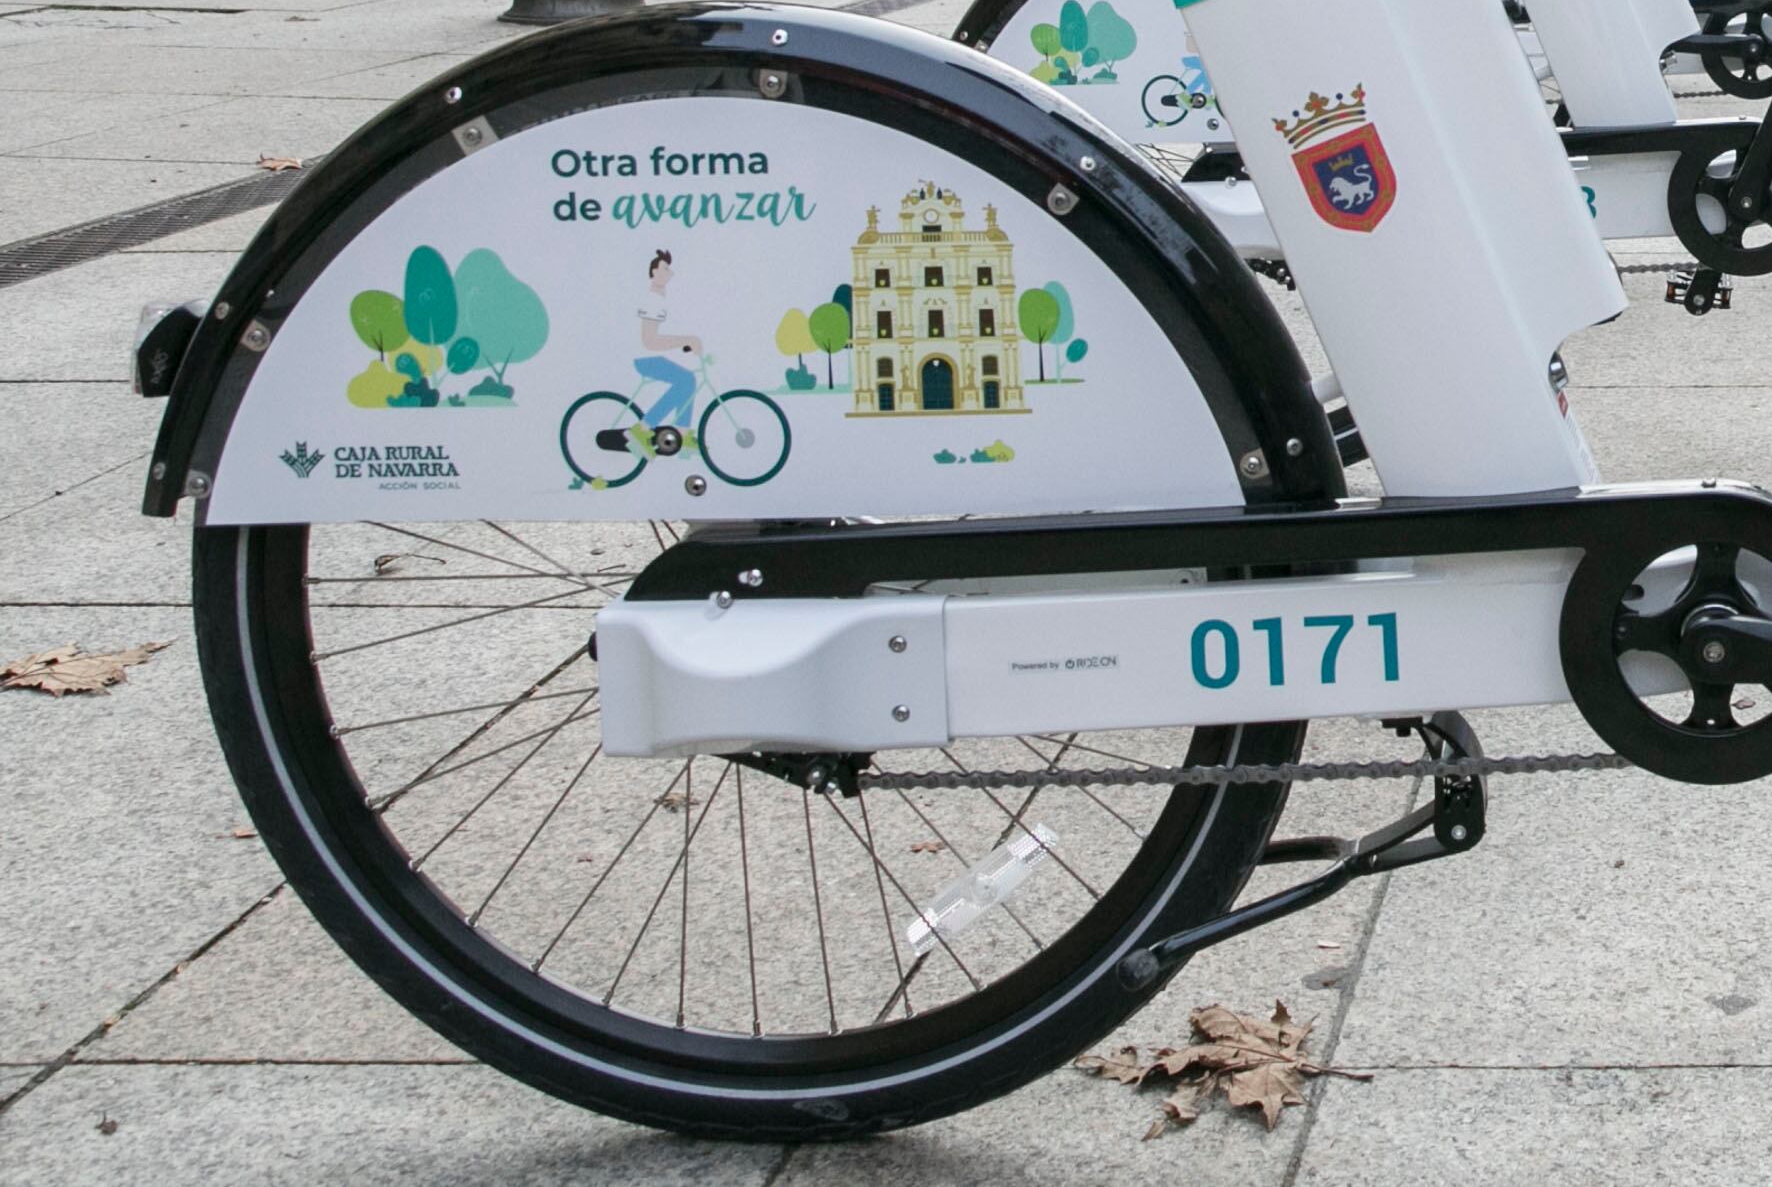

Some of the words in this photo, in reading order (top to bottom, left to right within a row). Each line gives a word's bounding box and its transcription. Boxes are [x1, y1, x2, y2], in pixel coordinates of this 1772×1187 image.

[551, 148, 637, 177] Otra
[649, 146, 769, 175] forma
[553, 192, 601, 221] de
[612, 186, 817, 228] avanzar
[334, 446, 380, 461] CAJA
[385, 446, 449, 460] RURAL
[335, 464, 362, 478] DE
[368, 462, 460, 477] NAVARRA
[423, 481, 461, 490] SOCIAL
[1190, 612, 1400, 690] 0171
